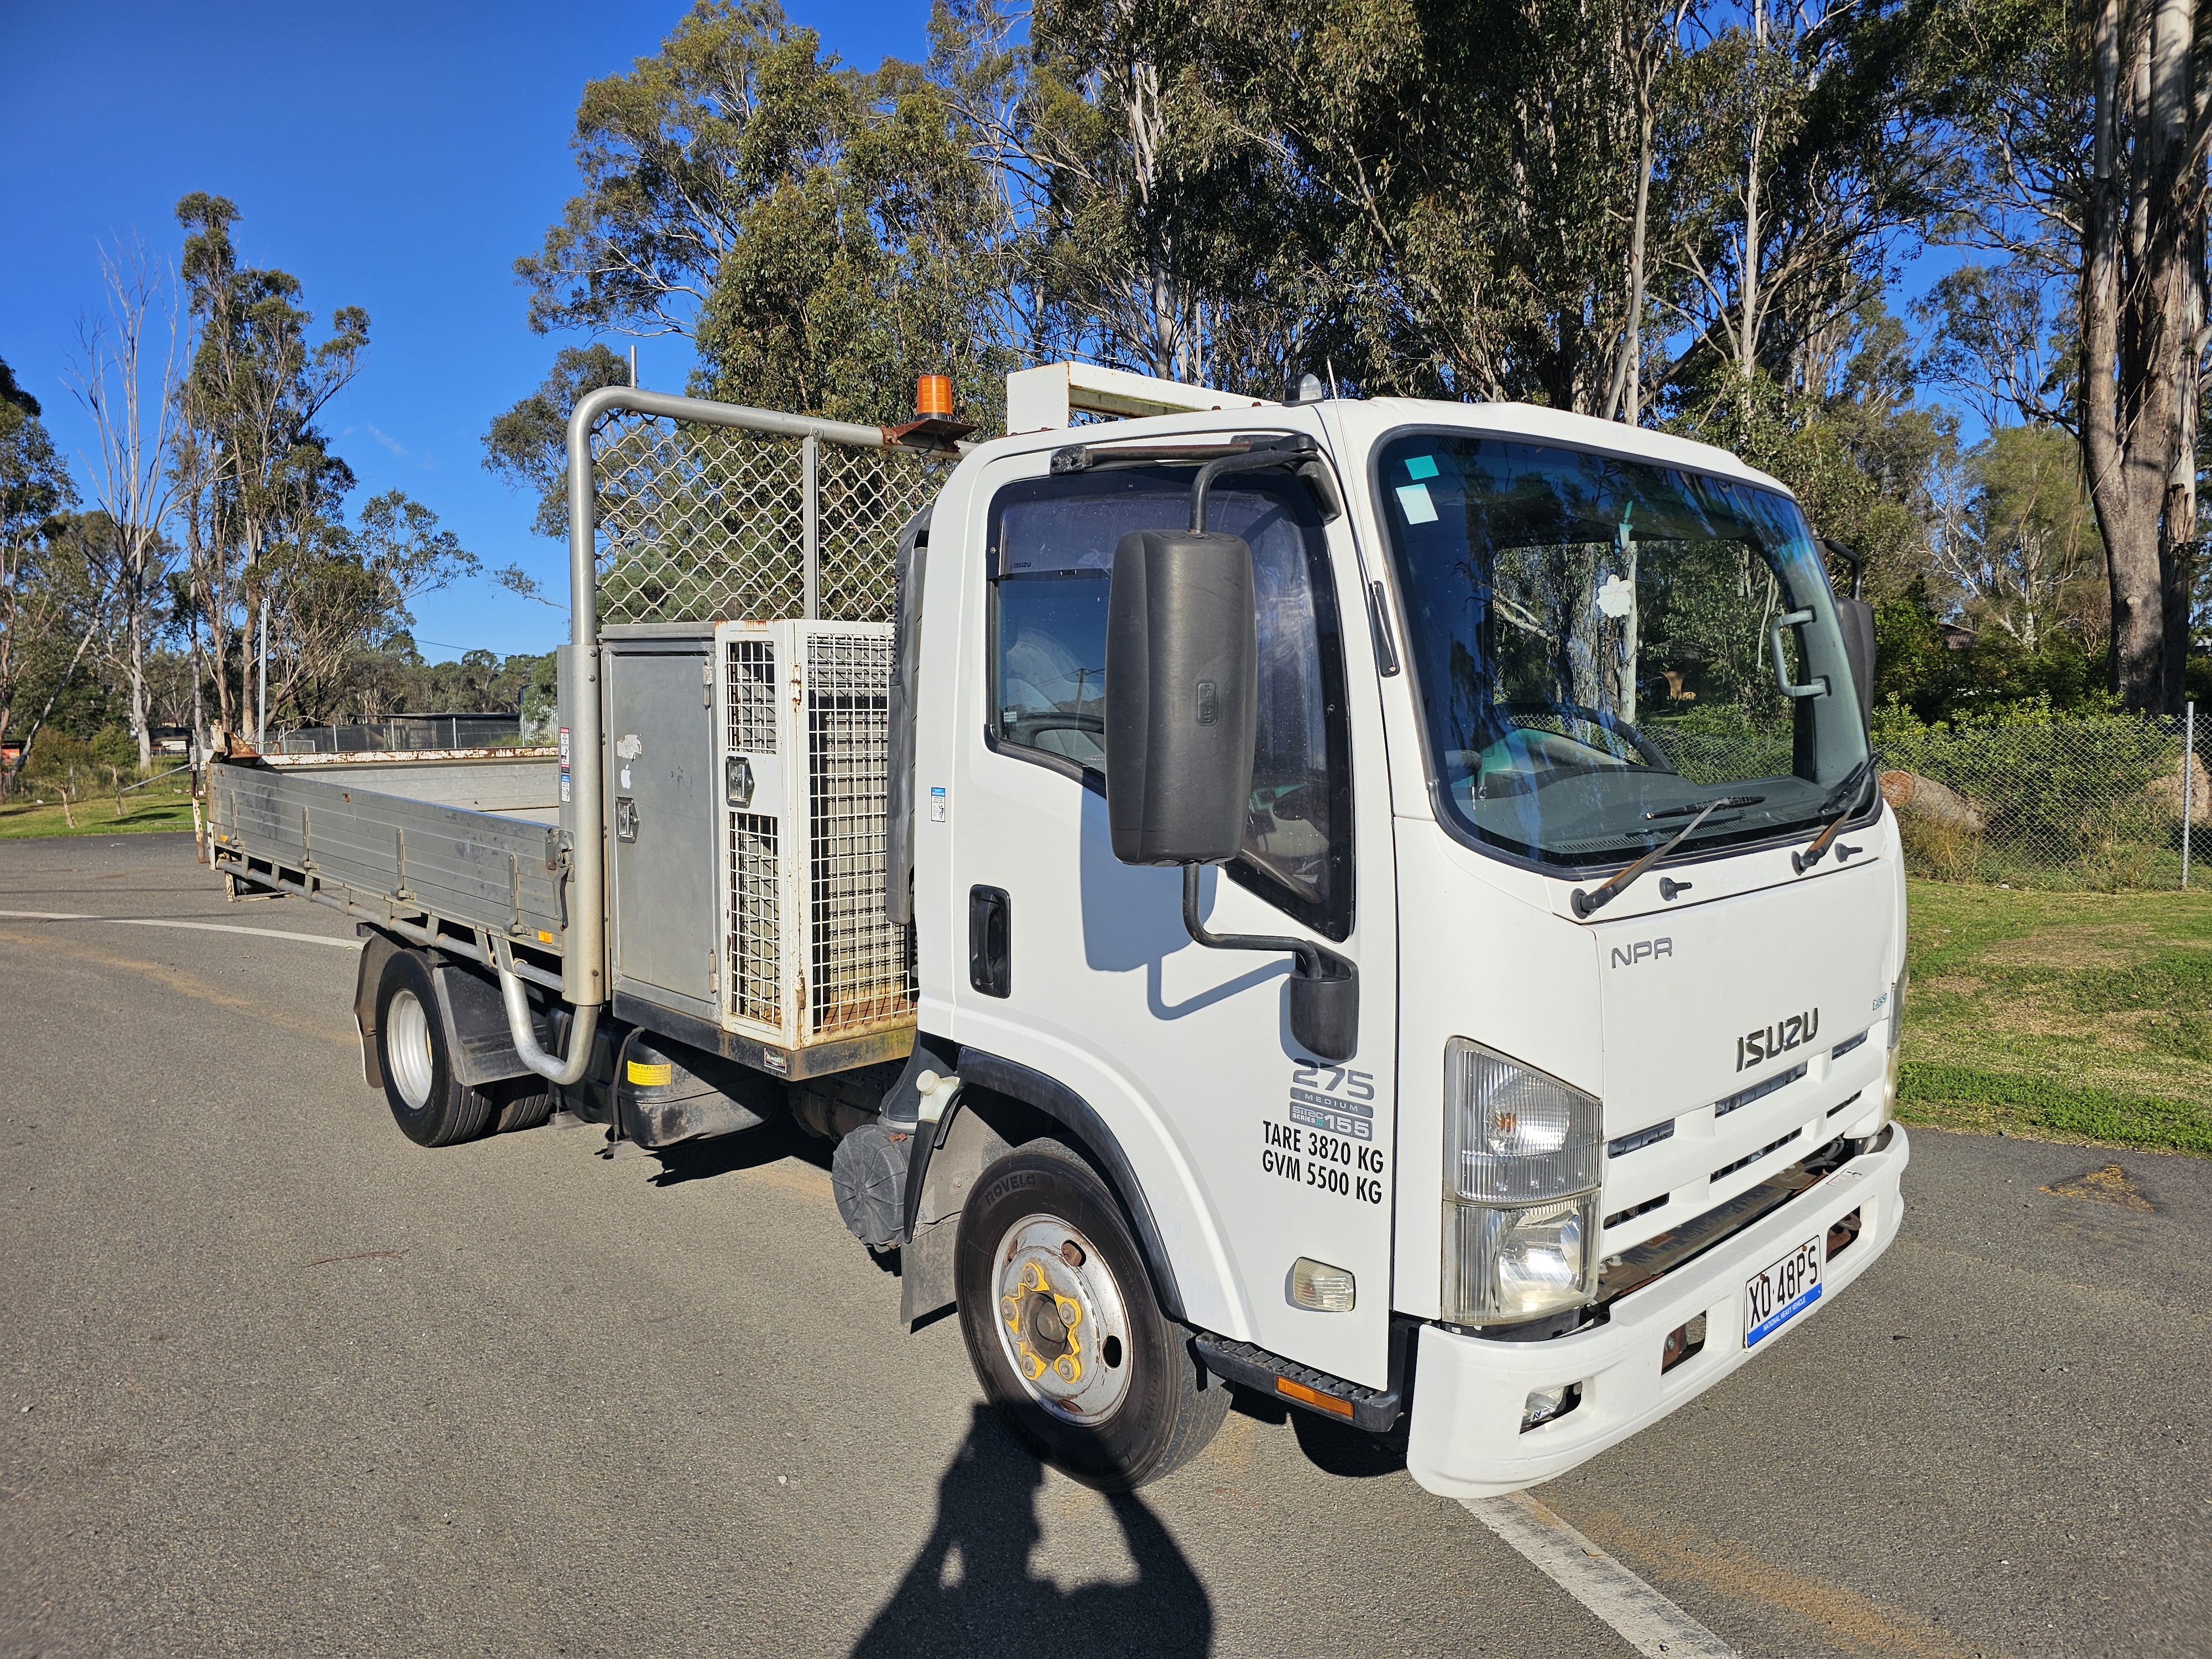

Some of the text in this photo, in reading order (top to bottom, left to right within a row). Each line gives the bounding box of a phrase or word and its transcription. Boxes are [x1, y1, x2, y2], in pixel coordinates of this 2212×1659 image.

[1612, 937, 1672, 969] NPR
[1736, 1008, 1818, 1072] ISUZU
[1292, 1058, 1374, 1100] 275
[1292, 1113, 1316, 1124] SERIES
[1305, 1093, 1358, 1112] MEDIUM
[1324, 1114, 1369, 1138] 155
[1263, 1120, 1384, 1173] TARE 3820 KG
[1262, 1150, 1382, 1204] GVM 5500 KG
[1762, 1296, 1806, 1332] NATIONAL HEAVY VEHICLE
